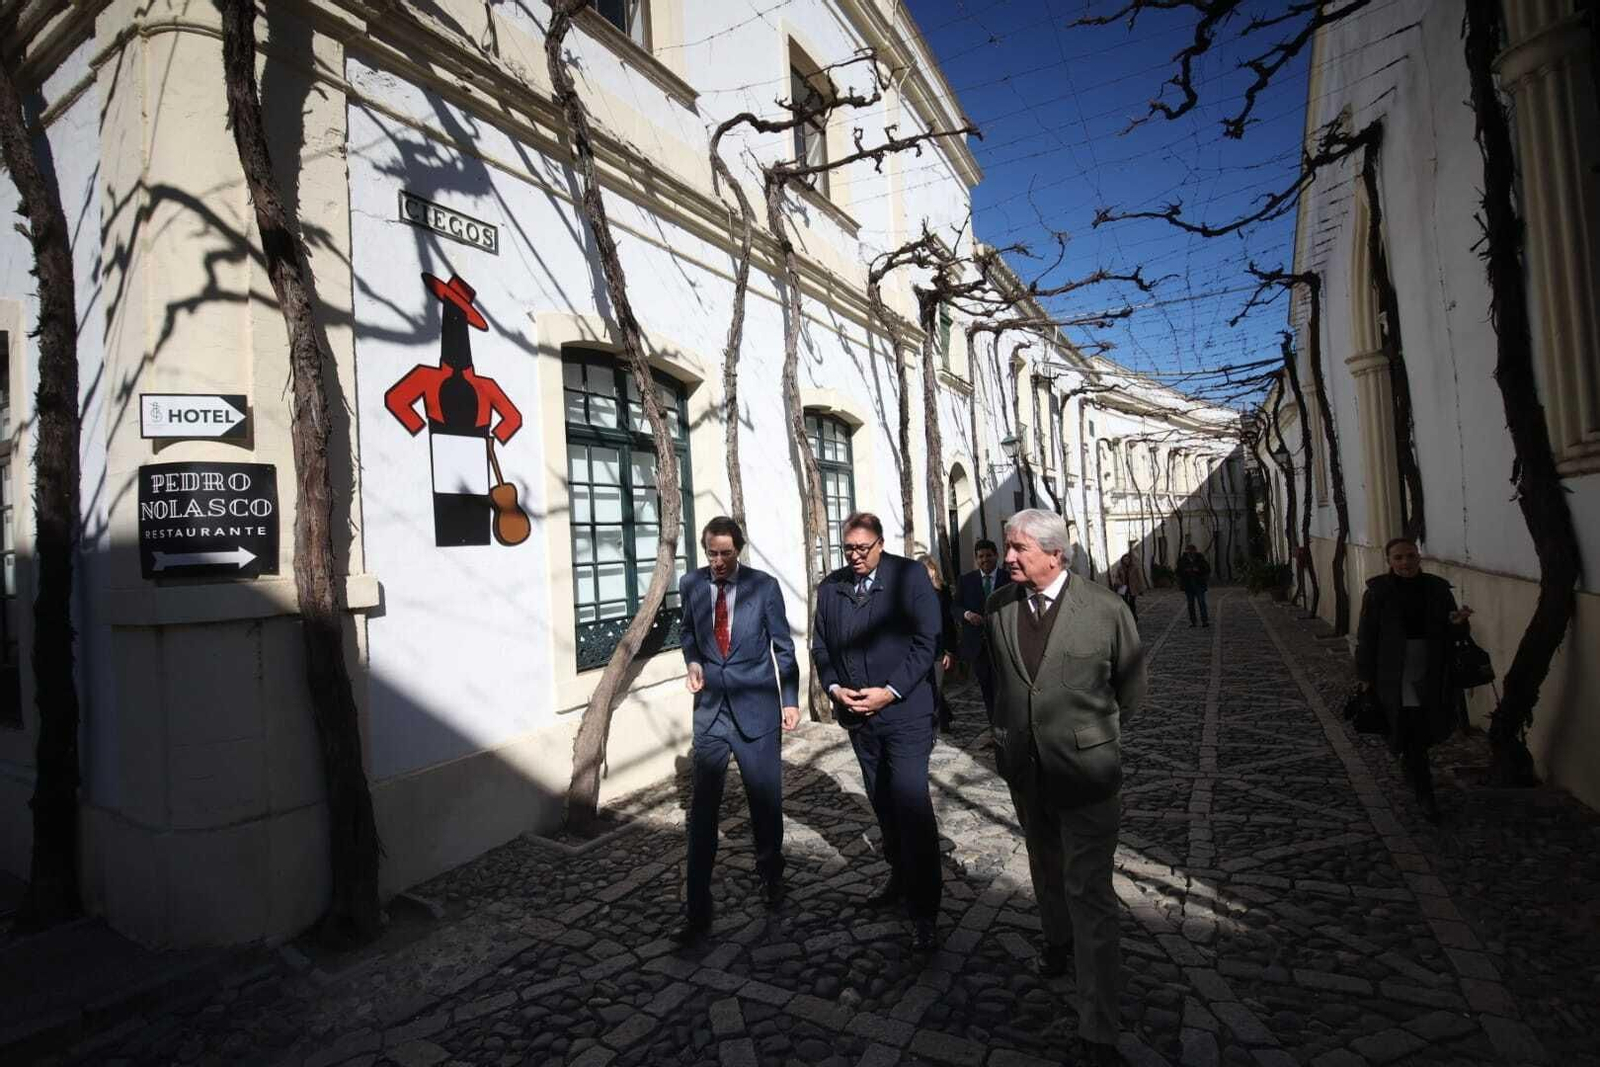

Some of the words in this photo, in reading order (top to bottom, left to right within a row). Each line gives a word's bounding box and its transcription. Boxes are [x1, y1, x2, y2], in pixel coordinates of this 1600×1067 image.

[405, 199, 494, 248] CIEGOS
[168, 409, 235, 424] HOTEL
[151, 472, 251, 494] PEDRO
[141, 498, 272, 521] NOLASCO
[145, 526, 267, 539] RESTAURANTE
